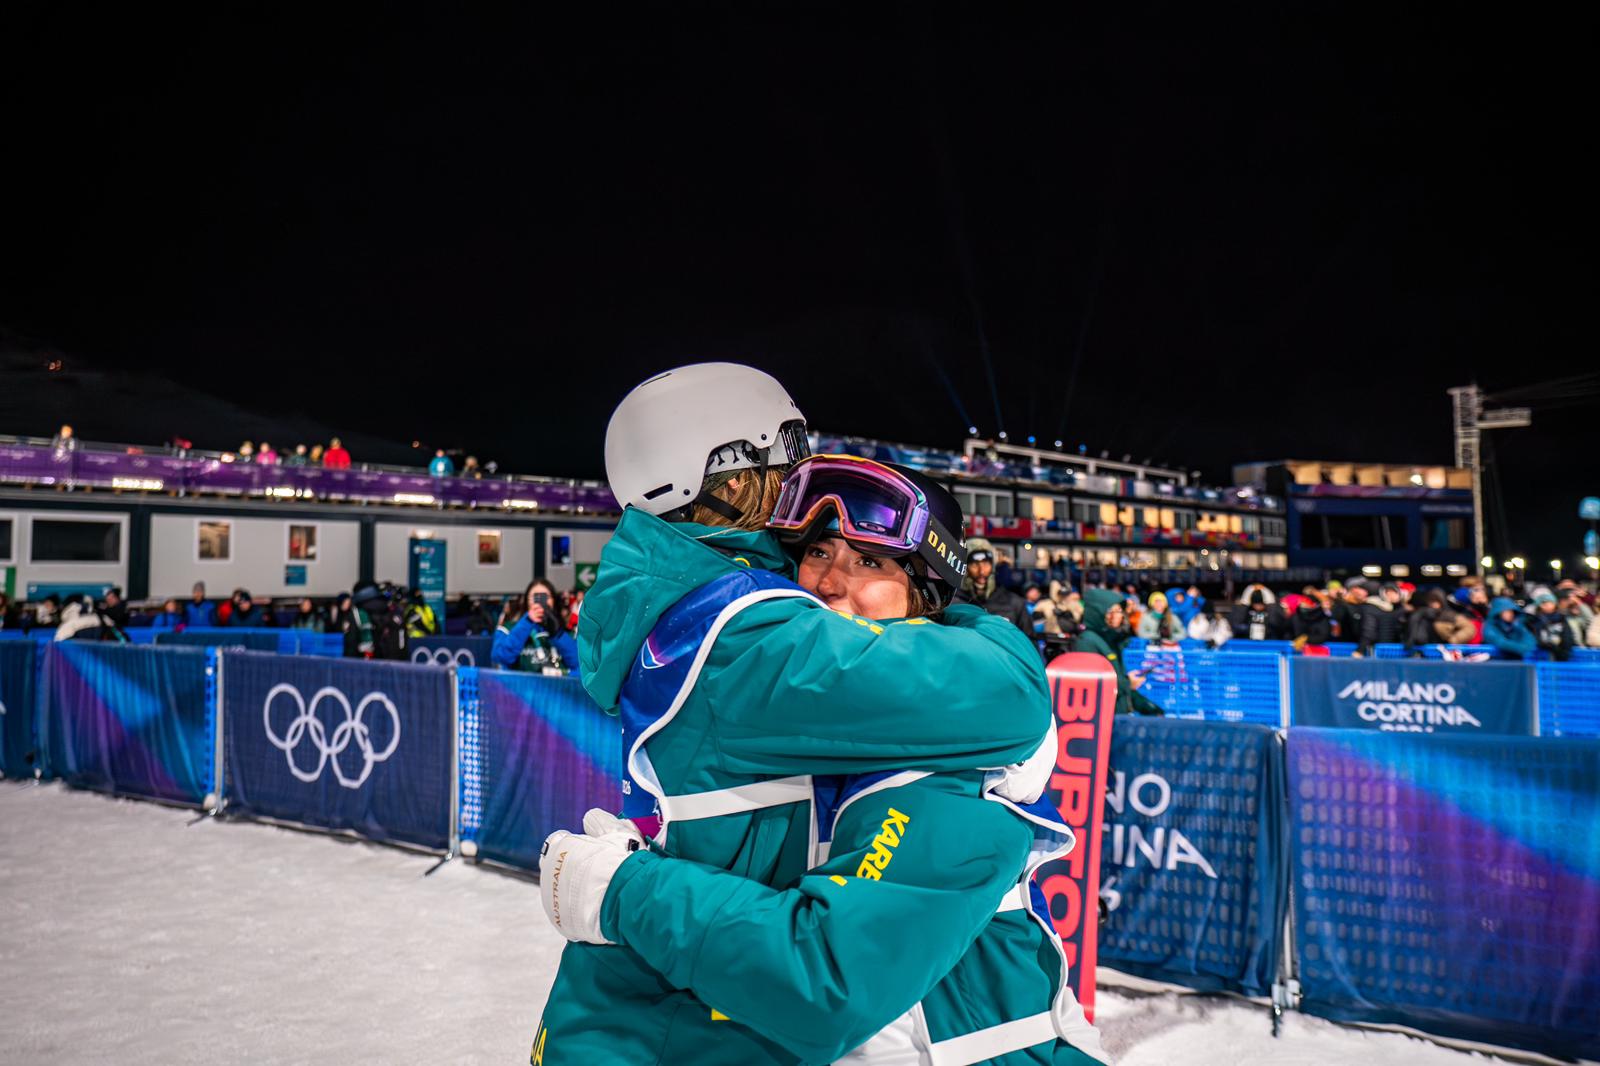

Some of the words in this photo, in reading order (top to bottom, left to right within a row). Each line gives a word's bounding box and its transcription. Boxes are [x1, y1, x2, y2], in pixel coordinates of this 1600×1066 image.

[928, 530, 967, 576] OAKLE
[1338, 680, 1456, 704] MILANO
[1357, 701, 1481, 727] CORTINA
[1041, 687, 1097, 968] BURTO
[553, 850, 568, 928] AUSTRALIA
